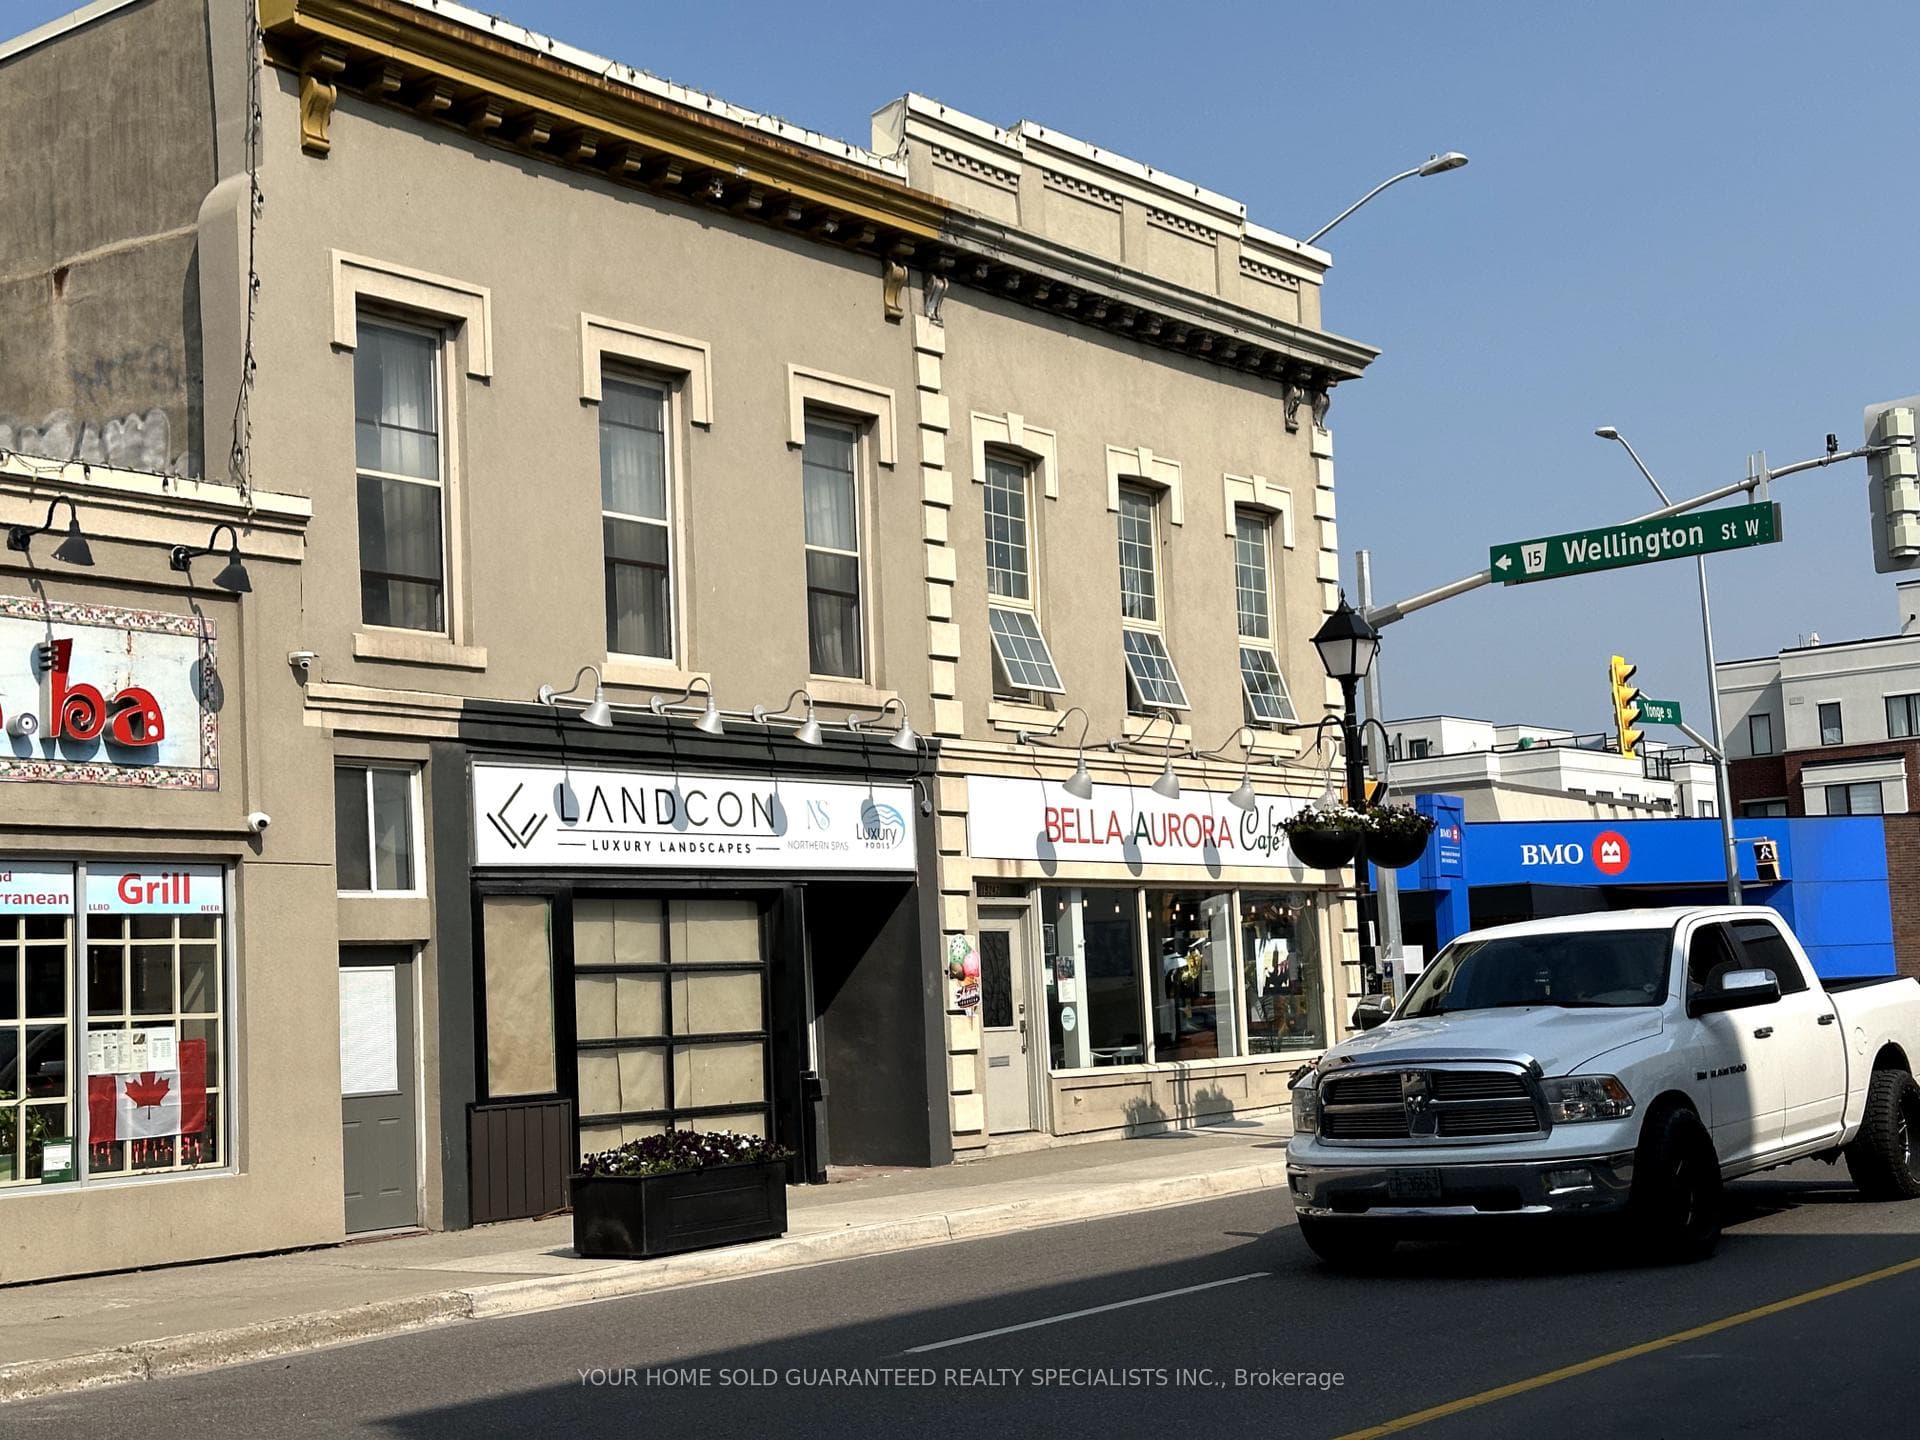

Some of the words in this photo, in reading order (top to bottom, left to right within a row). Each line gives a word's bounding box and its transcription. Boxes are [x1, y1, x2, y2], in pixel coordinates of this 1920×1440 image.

[1527, 550, 1542, 568] 15
[1562, 525, 1704, 565] Wellington
[1721, 521, 1737, 540] St
[1744, 518, 1760, 537] W
[1643, 702, 1665, 721] Yonge
[856, 822, 898, 845] Luxury
[1045, 806, 1125, 845] BELLA
[1133, 811, 1235, 850] AURORA
[592, 839, 651, 851] LUXURY
[660, 841, 752, 854] LANDSCAPES
[787, 840, 830, 850] NORTHERN
[831, 841, 849, 851] SPAS
[1521, 843, 1584, 866] BMO
[117, 871, 191, 905] Grill
